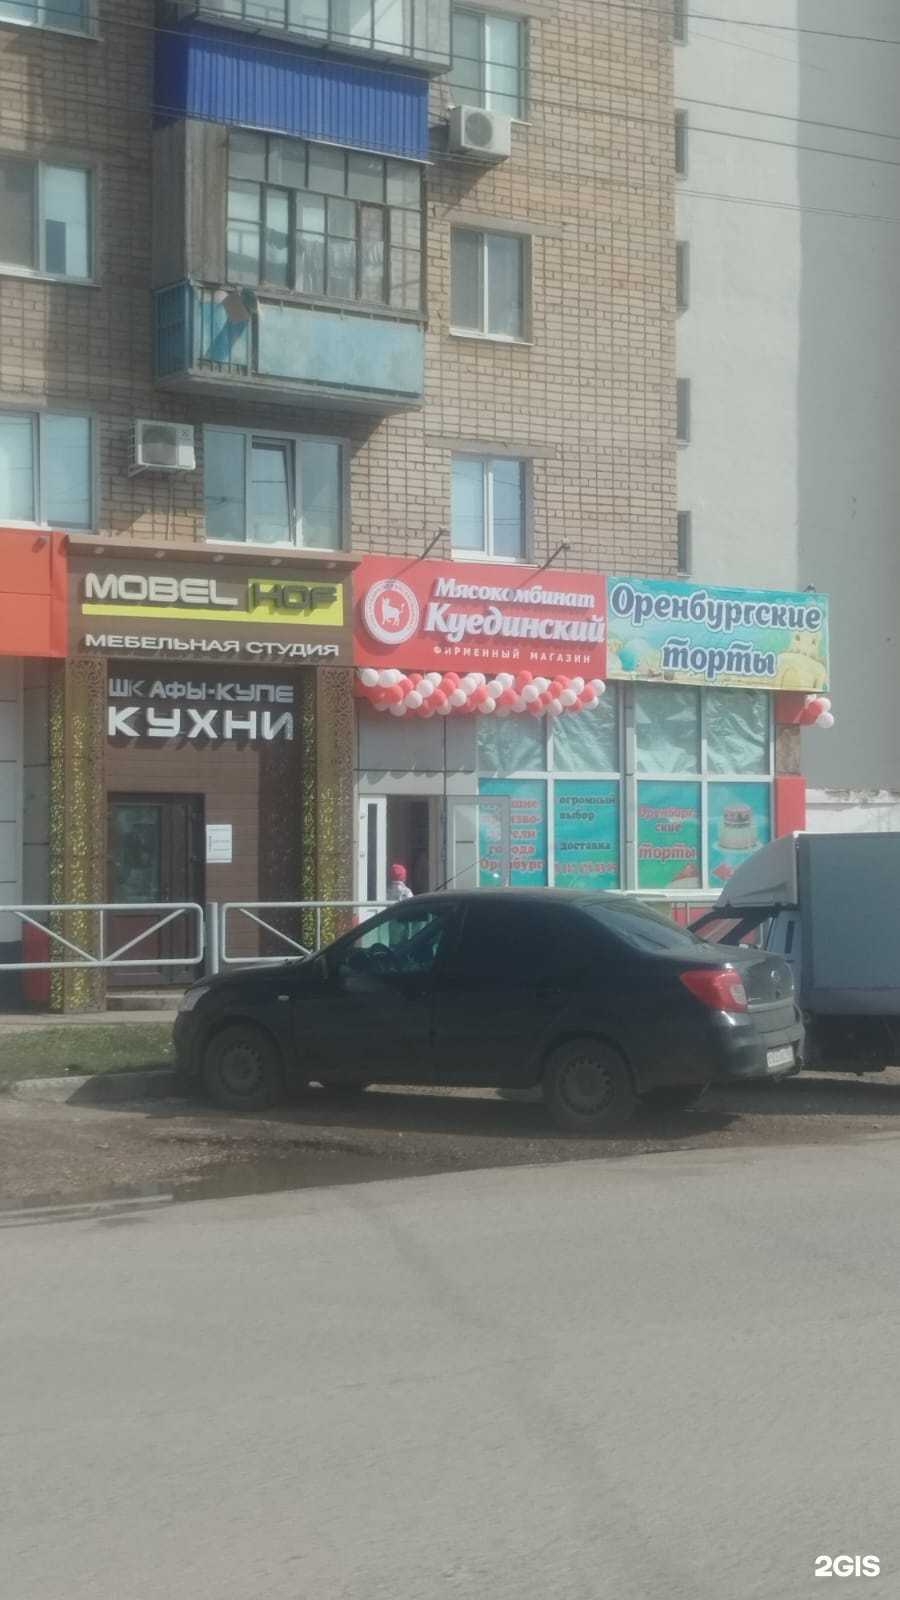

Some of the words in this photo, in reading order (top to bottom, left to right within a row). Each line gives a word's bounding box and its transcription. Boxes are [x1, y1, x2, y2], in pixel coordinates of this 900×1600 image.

[84, 572, 239, 606] MOBEL
[253, 582, 338, 611] HOF
[433, 577, 596, 609] Мясокомбинат
[611, 582, 822, 633] Оренбургские
[424, 602, 606, 643] Куединский
[85, 633, 240, 653] МЕБЕЛЬНАЯ
[245, 640, 340, 657] СТУДИЯ
[433, 645, 520, 659] ФИРМЕННЫЙ
[529, 651, 592, 664] МАГАЗИН
[662, 636, 776, 682] торты
[107, 706, 294, 740] КУХНИ
